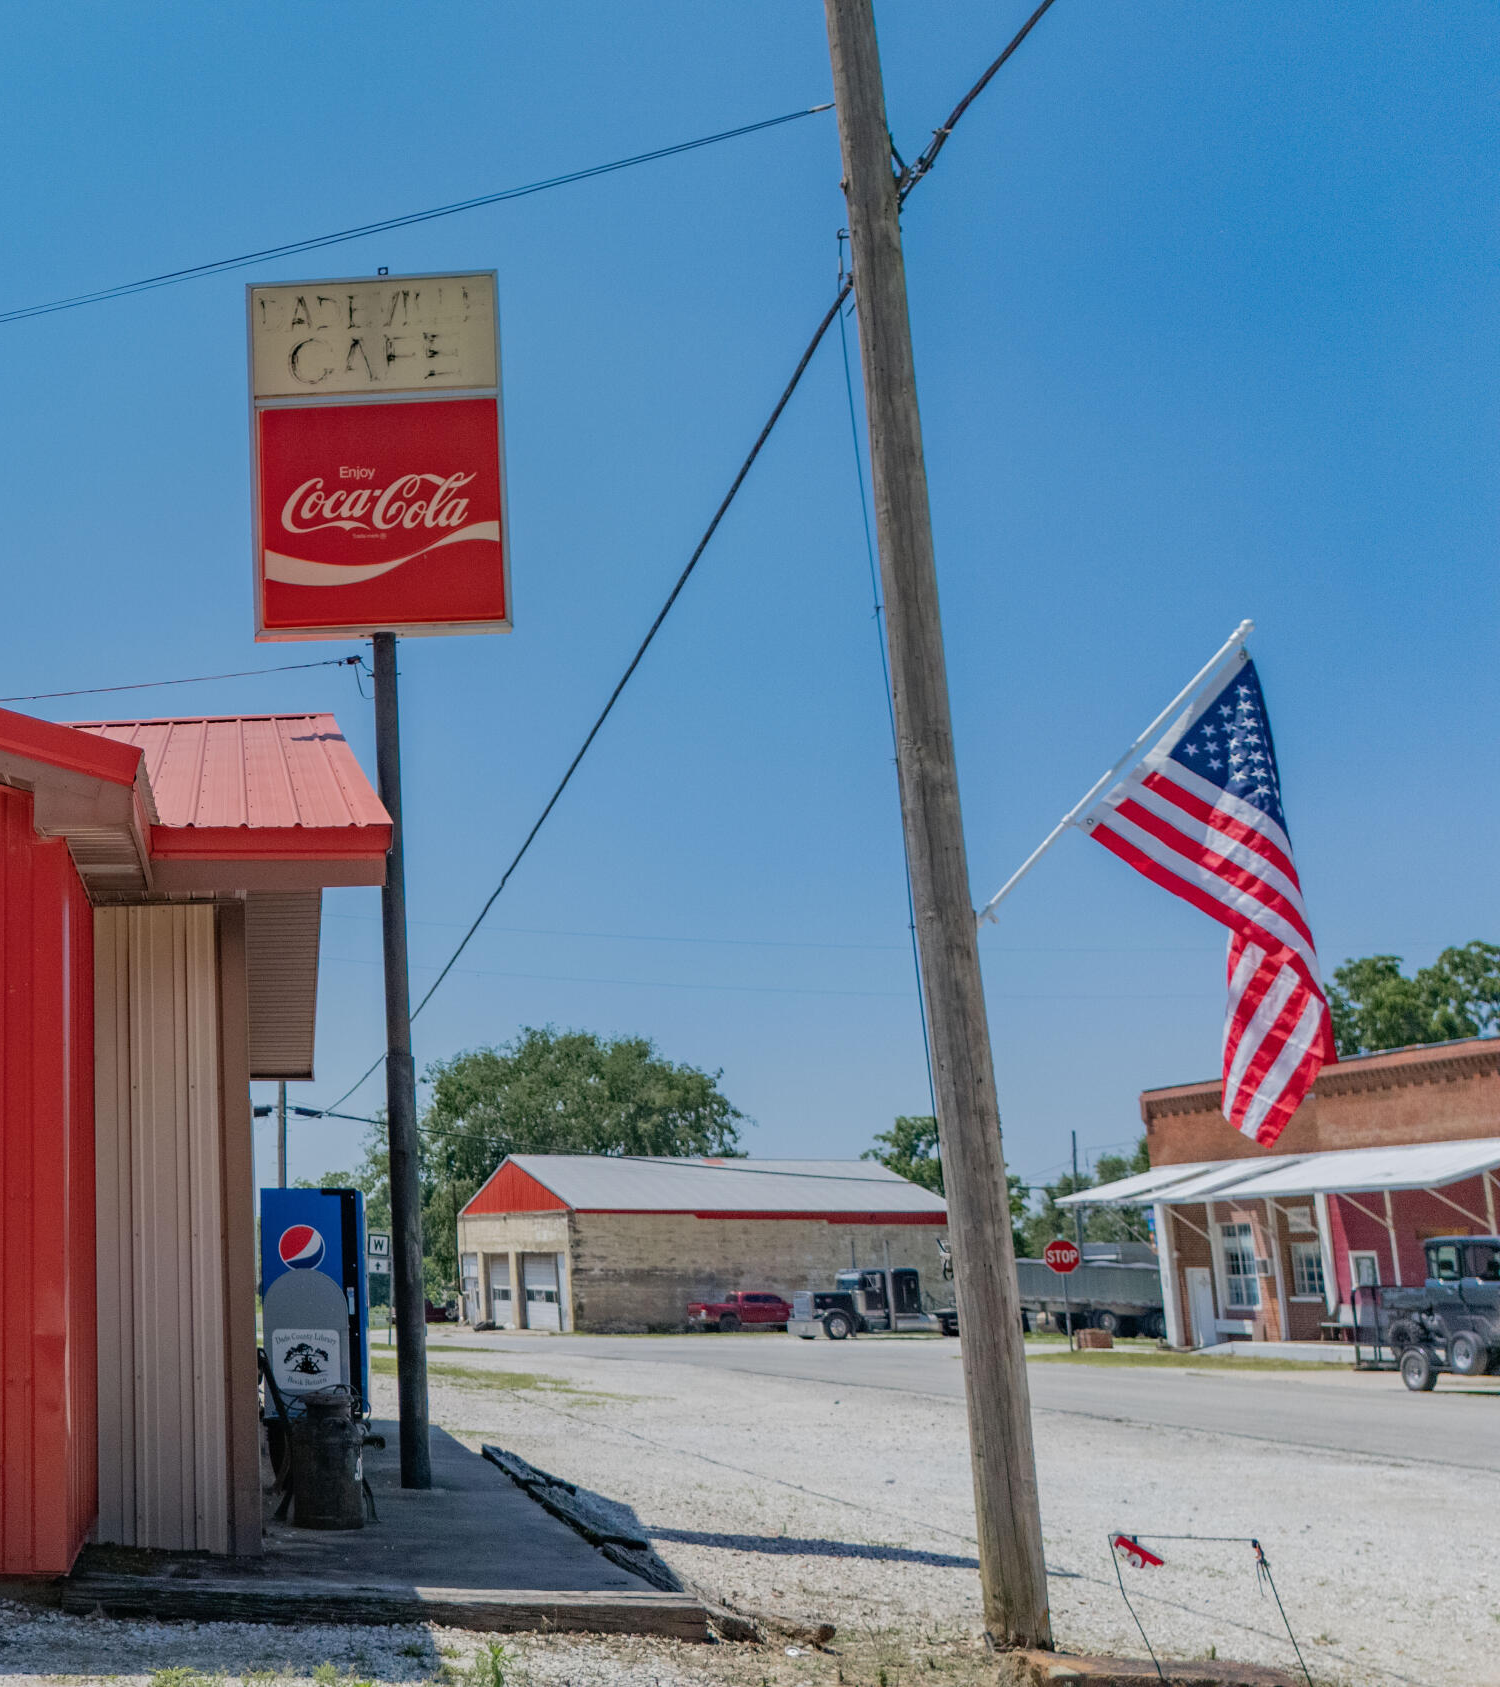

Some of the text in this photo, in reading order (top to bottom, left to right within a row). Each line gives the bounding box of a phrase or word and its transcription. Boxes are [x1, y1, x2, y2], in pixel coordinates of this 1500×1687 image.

[259, 286, 484, 332] DADEVI
[288, 332, 462, 384] CAFE
[339, 466, 375, 480] Enjoy
[281, 472, 477, 533] Coca-Cola
[374, 1239, 384, 1251] W
[1047, 1249, 1077, 1264] STOP
[314, 1333, 336, 1345] Library
